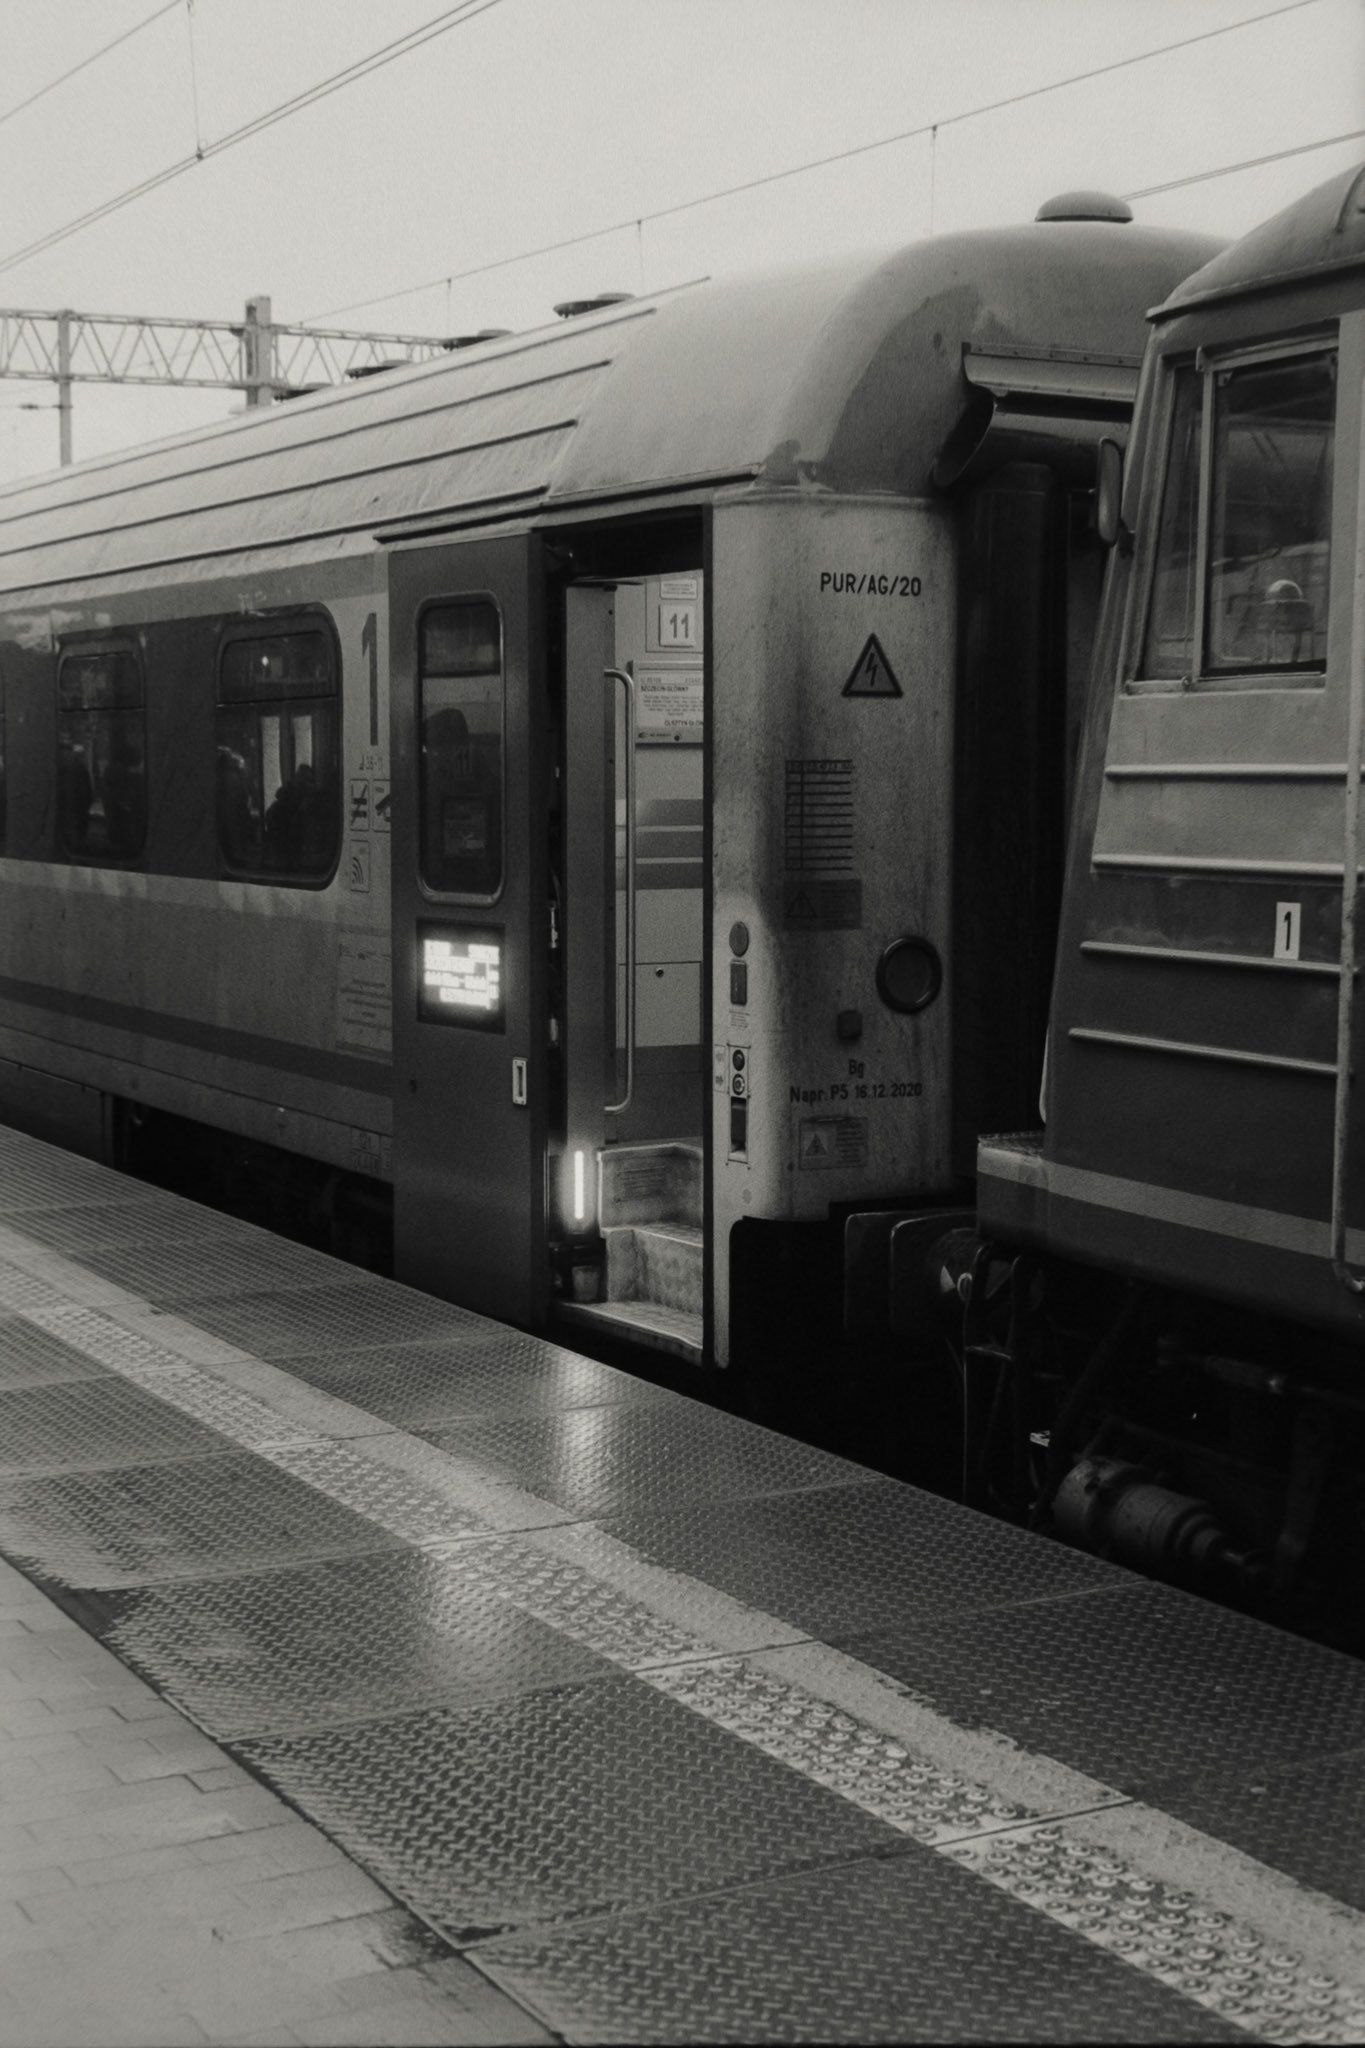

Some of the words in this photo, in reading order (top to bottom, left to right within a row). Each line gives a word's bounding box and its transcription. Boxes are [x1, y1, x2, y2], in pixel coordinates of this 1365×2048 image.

[821, 572, 922, 597] PUR/AG/20
[669, 613, 689, 639] 11
[362, 612, 378, 746] 1
[1284, 911, 1292, 951] 1
[848, 1059, 864, 1079] Bg
